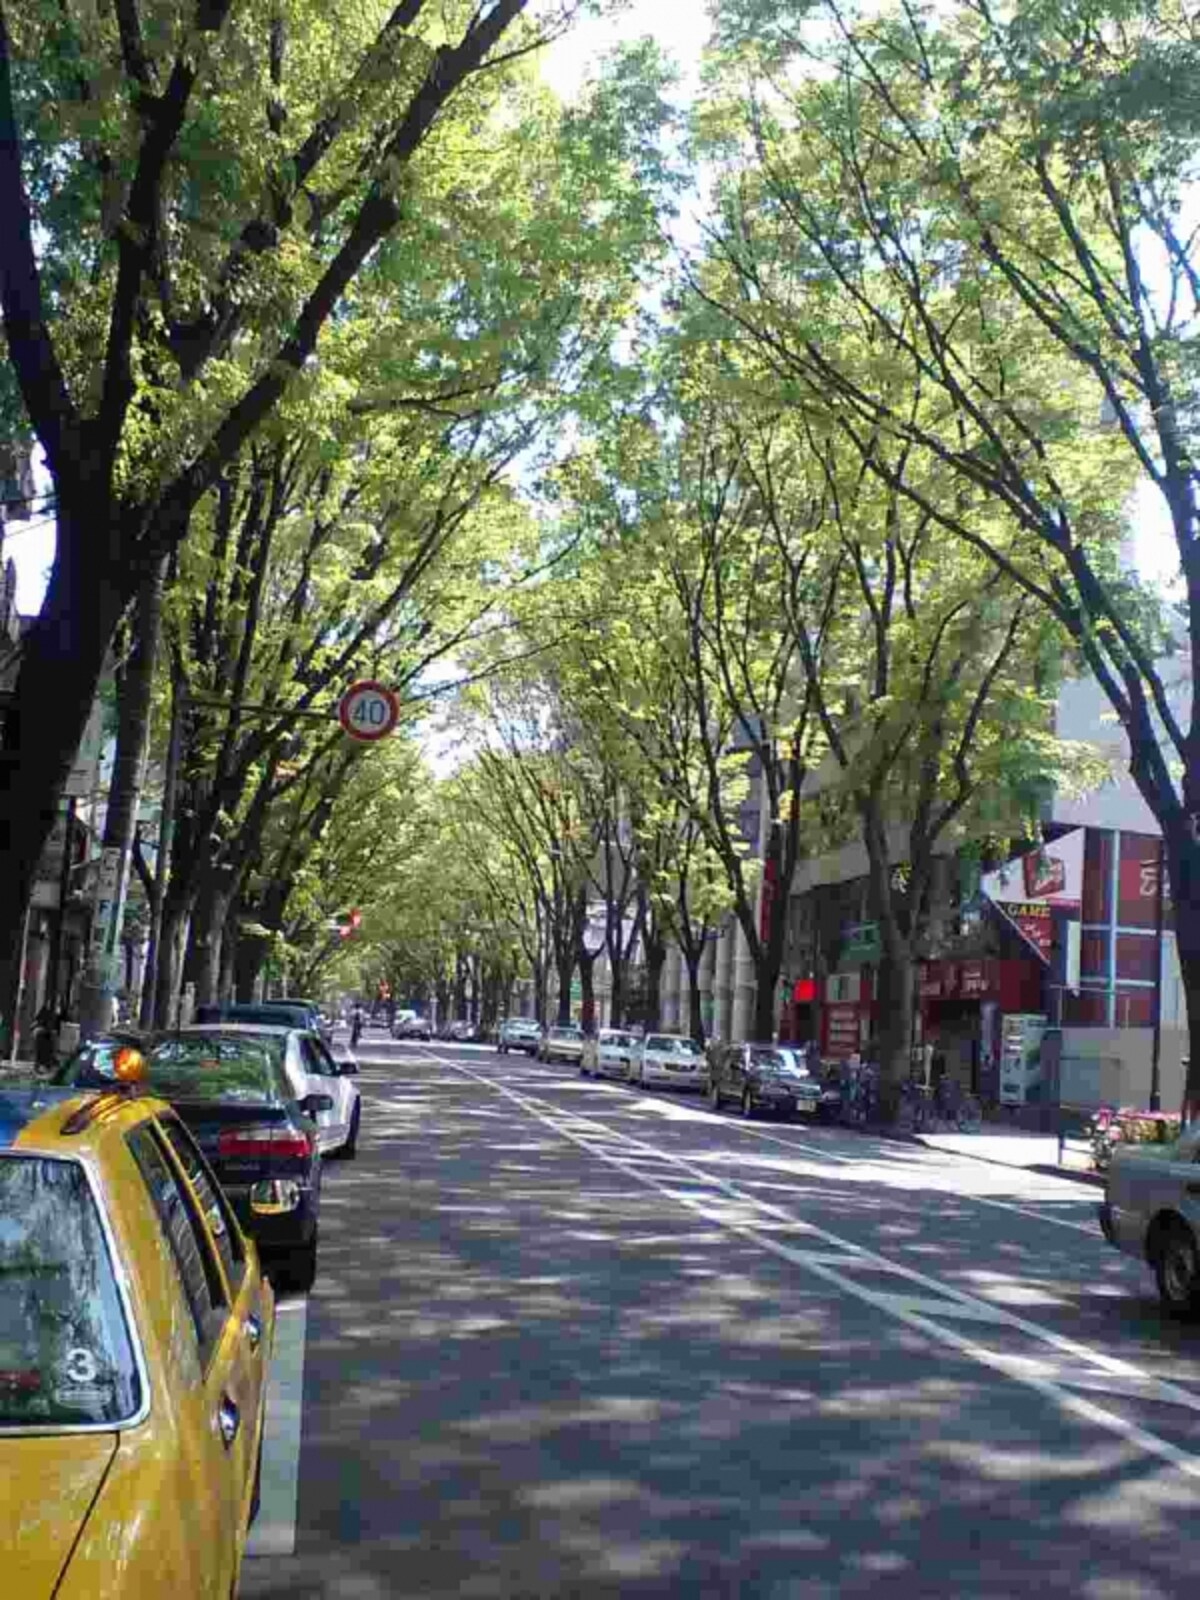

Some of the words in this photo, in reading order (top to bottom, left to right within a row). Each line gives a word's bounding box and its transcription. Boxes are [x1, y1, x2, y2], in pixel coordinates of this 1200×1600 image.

[351, 700, 386, 725] 40
[1007, 903, 1051, 918] GAME
[66, 1347, 97, 1382] 3
